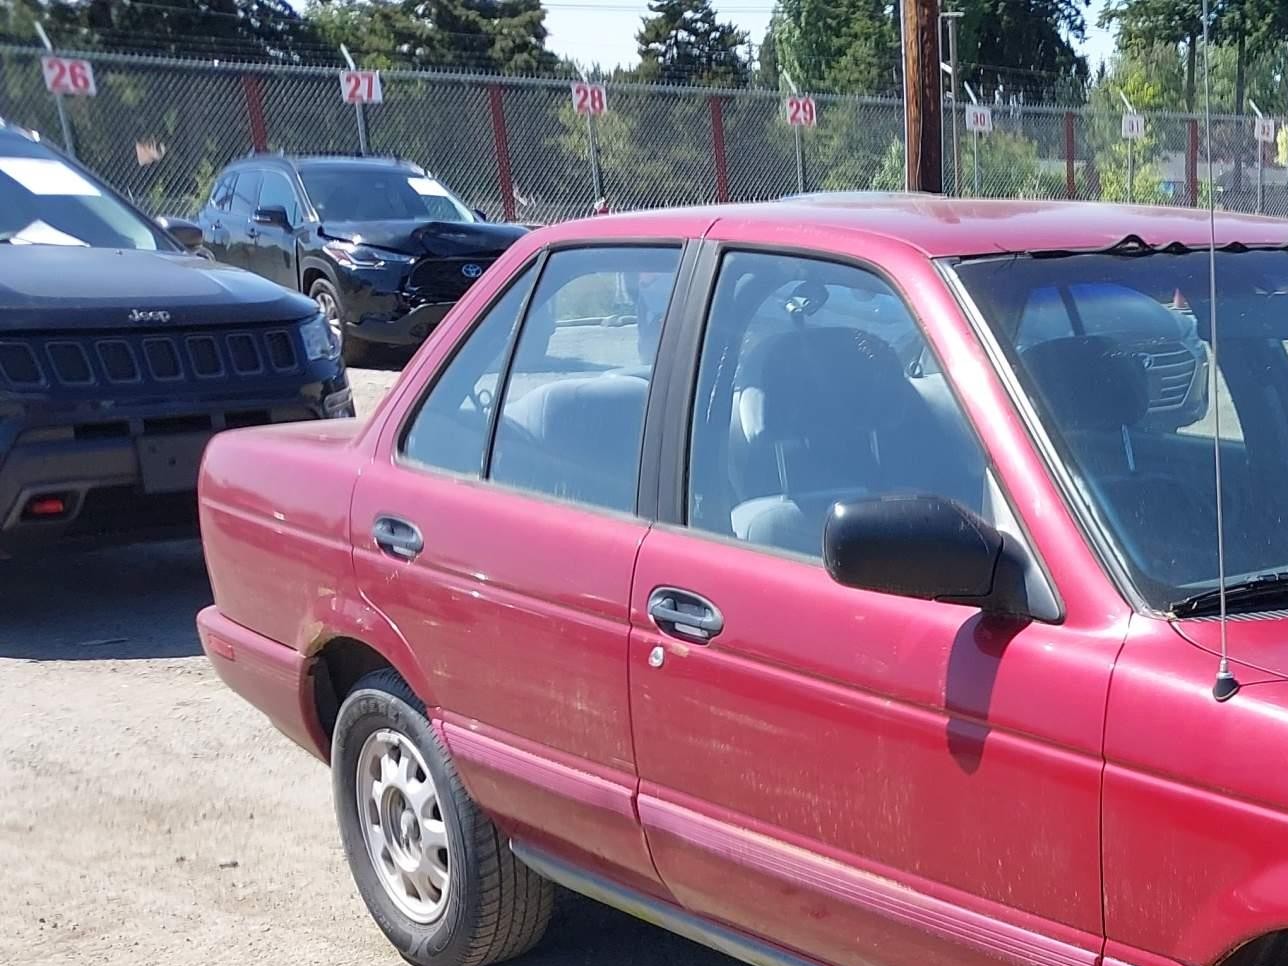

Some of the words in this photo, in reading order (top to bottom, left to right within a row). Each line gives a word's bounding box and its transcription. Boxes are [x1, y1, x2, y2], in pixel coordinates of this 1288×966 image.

[47, 58, 90, 95] 26
[346, 72, 374, 103] 27
[575, 84, 604, 113] 28
[788, 97, 814, 126] 29
[128, 308, 171, 323] Jeep
